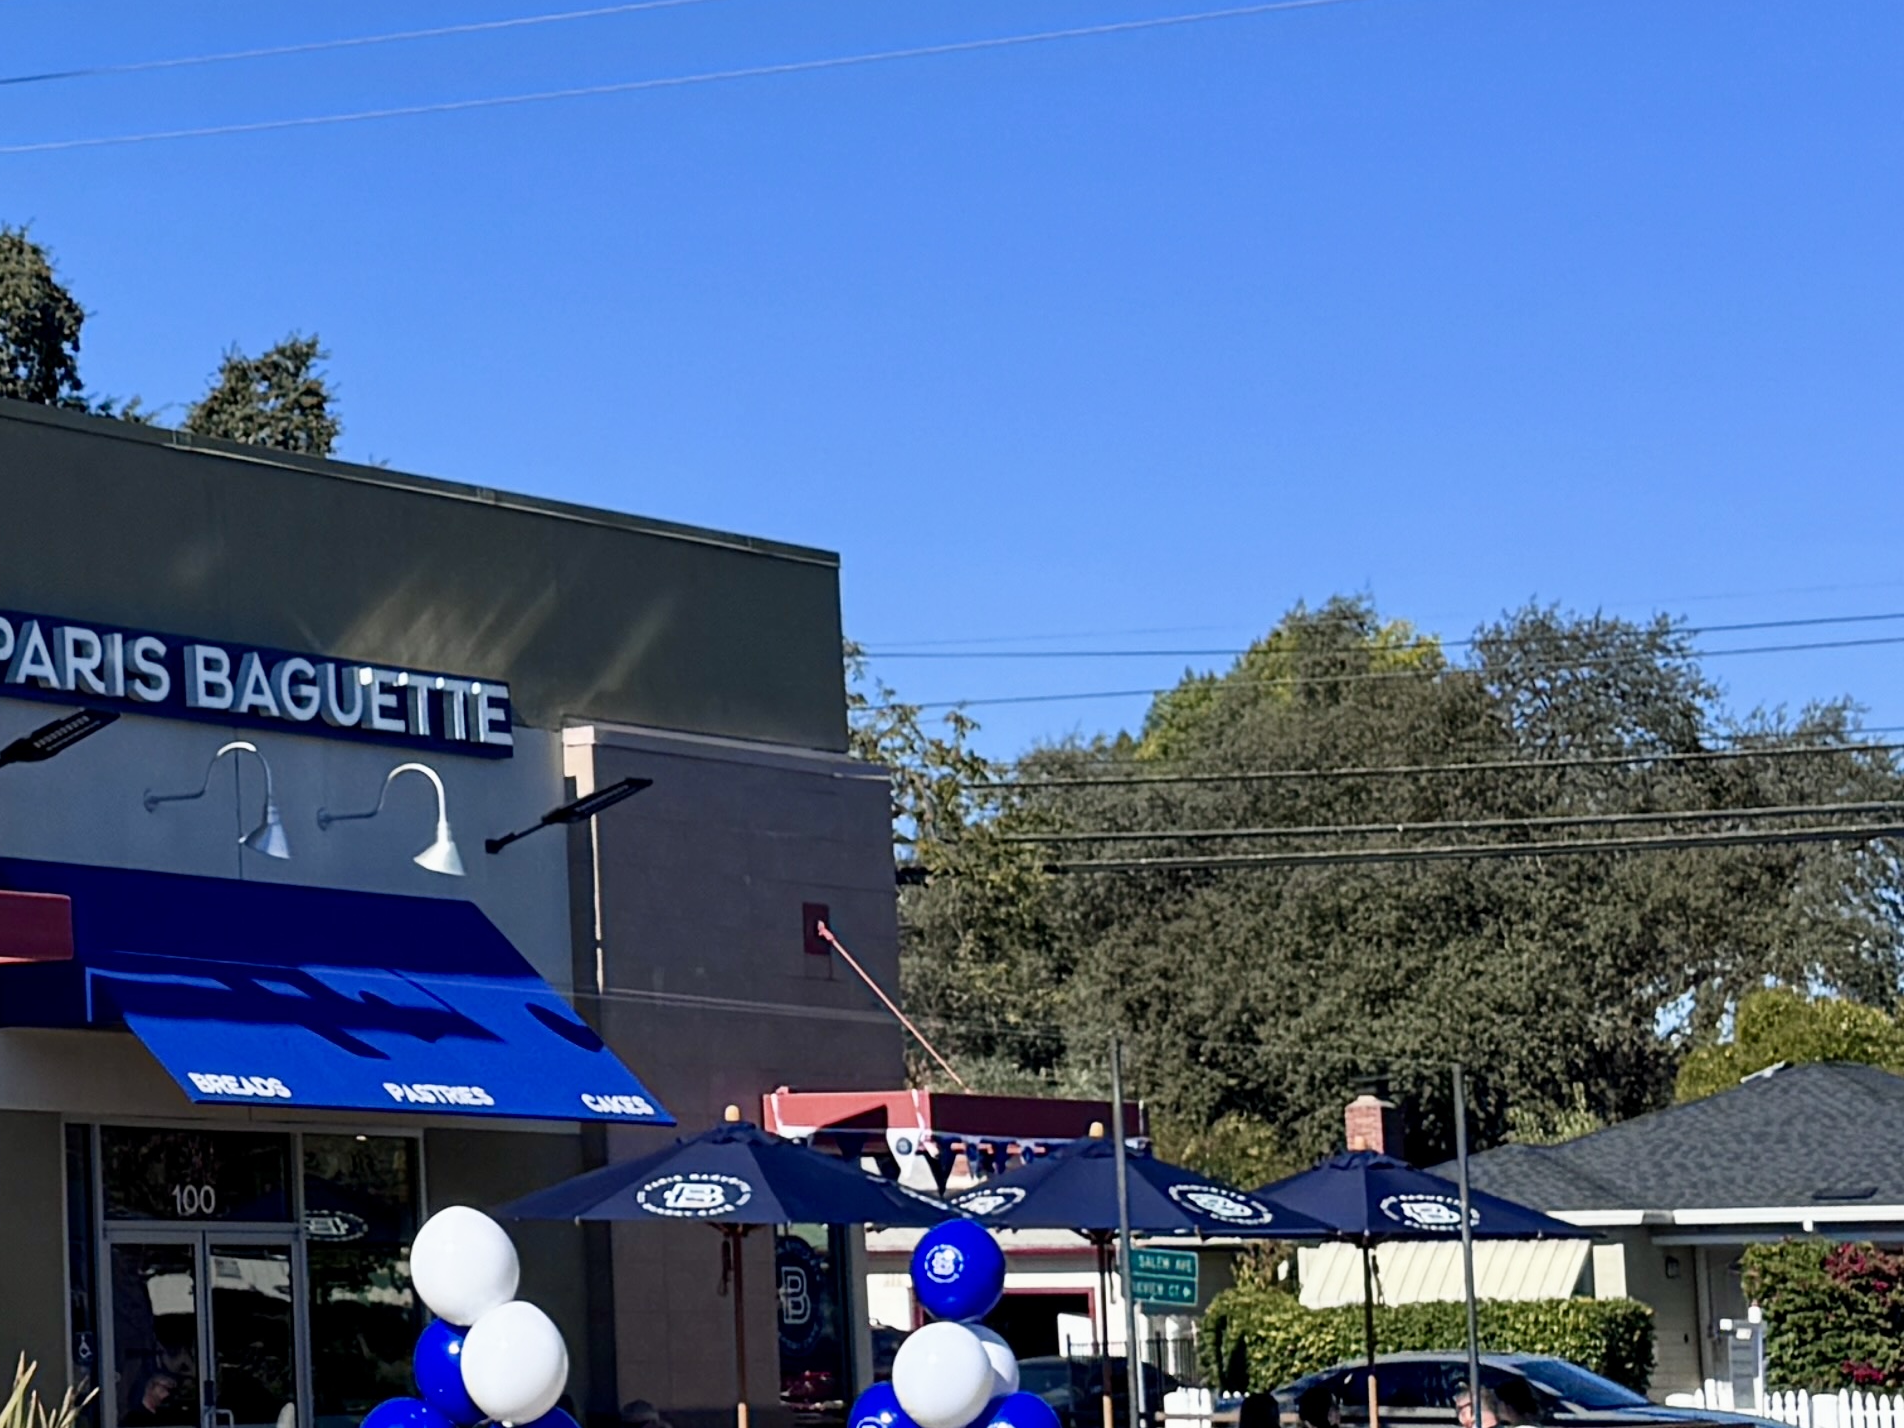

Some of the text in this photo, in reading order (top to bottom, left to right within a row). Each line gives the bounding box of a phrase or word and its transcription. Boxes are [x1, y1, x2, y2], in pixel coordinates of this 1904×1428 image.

[182, 643, 514, 746] BAGUETTE
[188, 1071, 656, 1116] BREADS PASTRIES CAKES
[171, 1183, 216, 1215] 100
